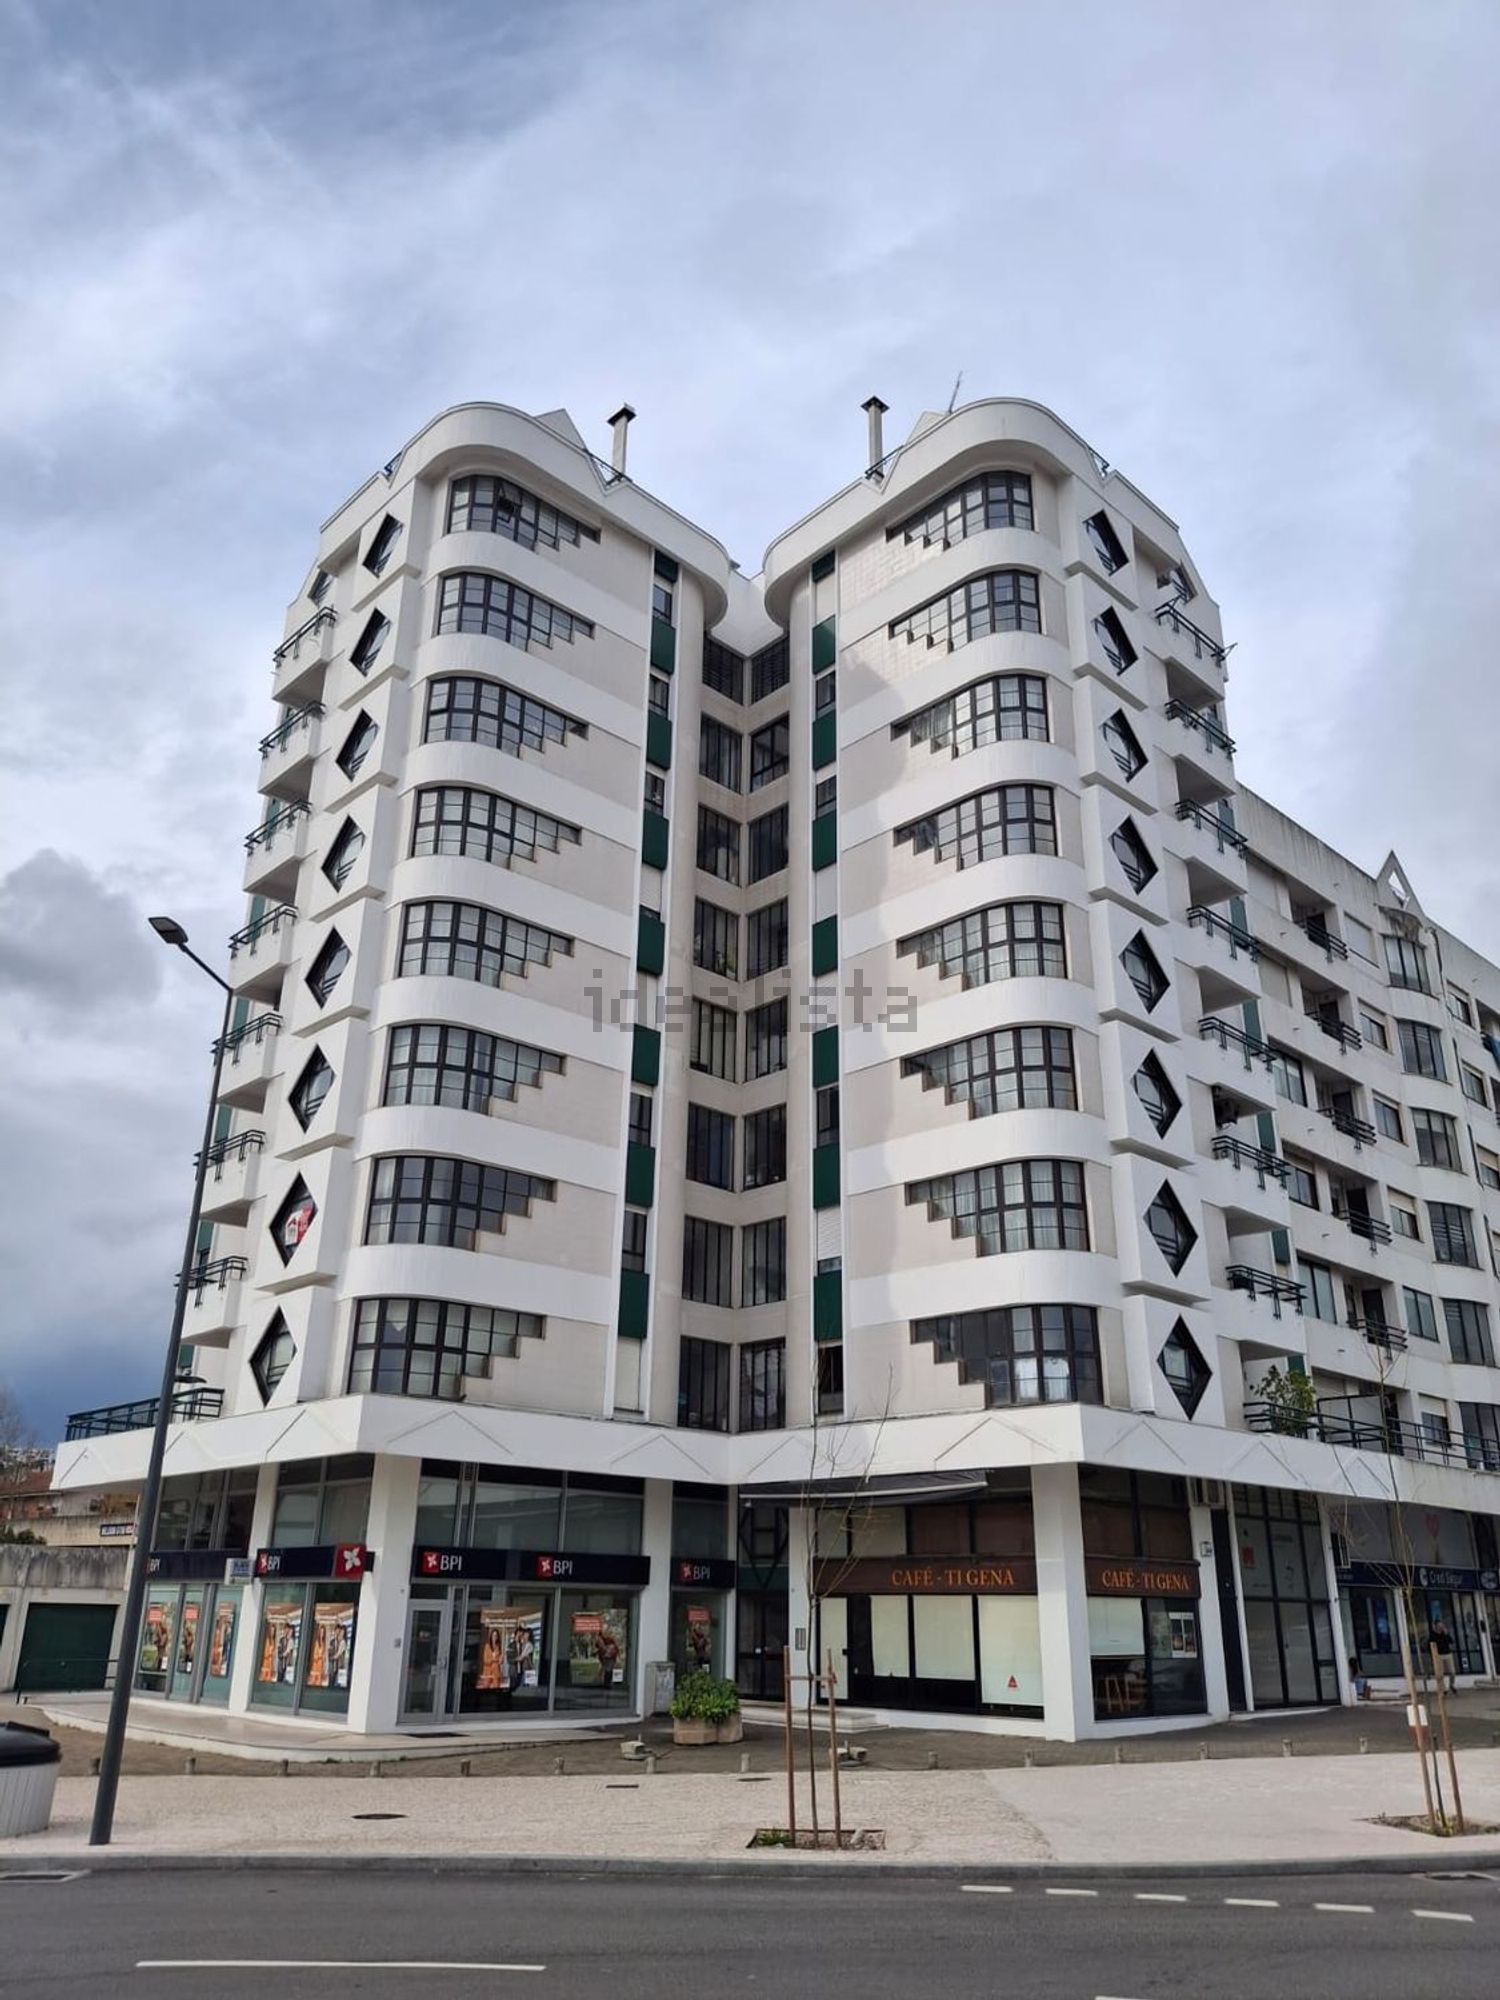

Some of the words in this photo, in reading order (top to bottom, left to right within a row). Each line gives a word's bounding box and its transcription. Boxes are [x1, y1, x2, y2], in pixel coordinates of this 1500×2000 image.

[440, 1555, 462, 1571] BPI
[553, 1560, 573, 1575] BPI
[693, 1566, 710, 1580] BPI
[891, 1565, 934, 1586] CAFÉ
